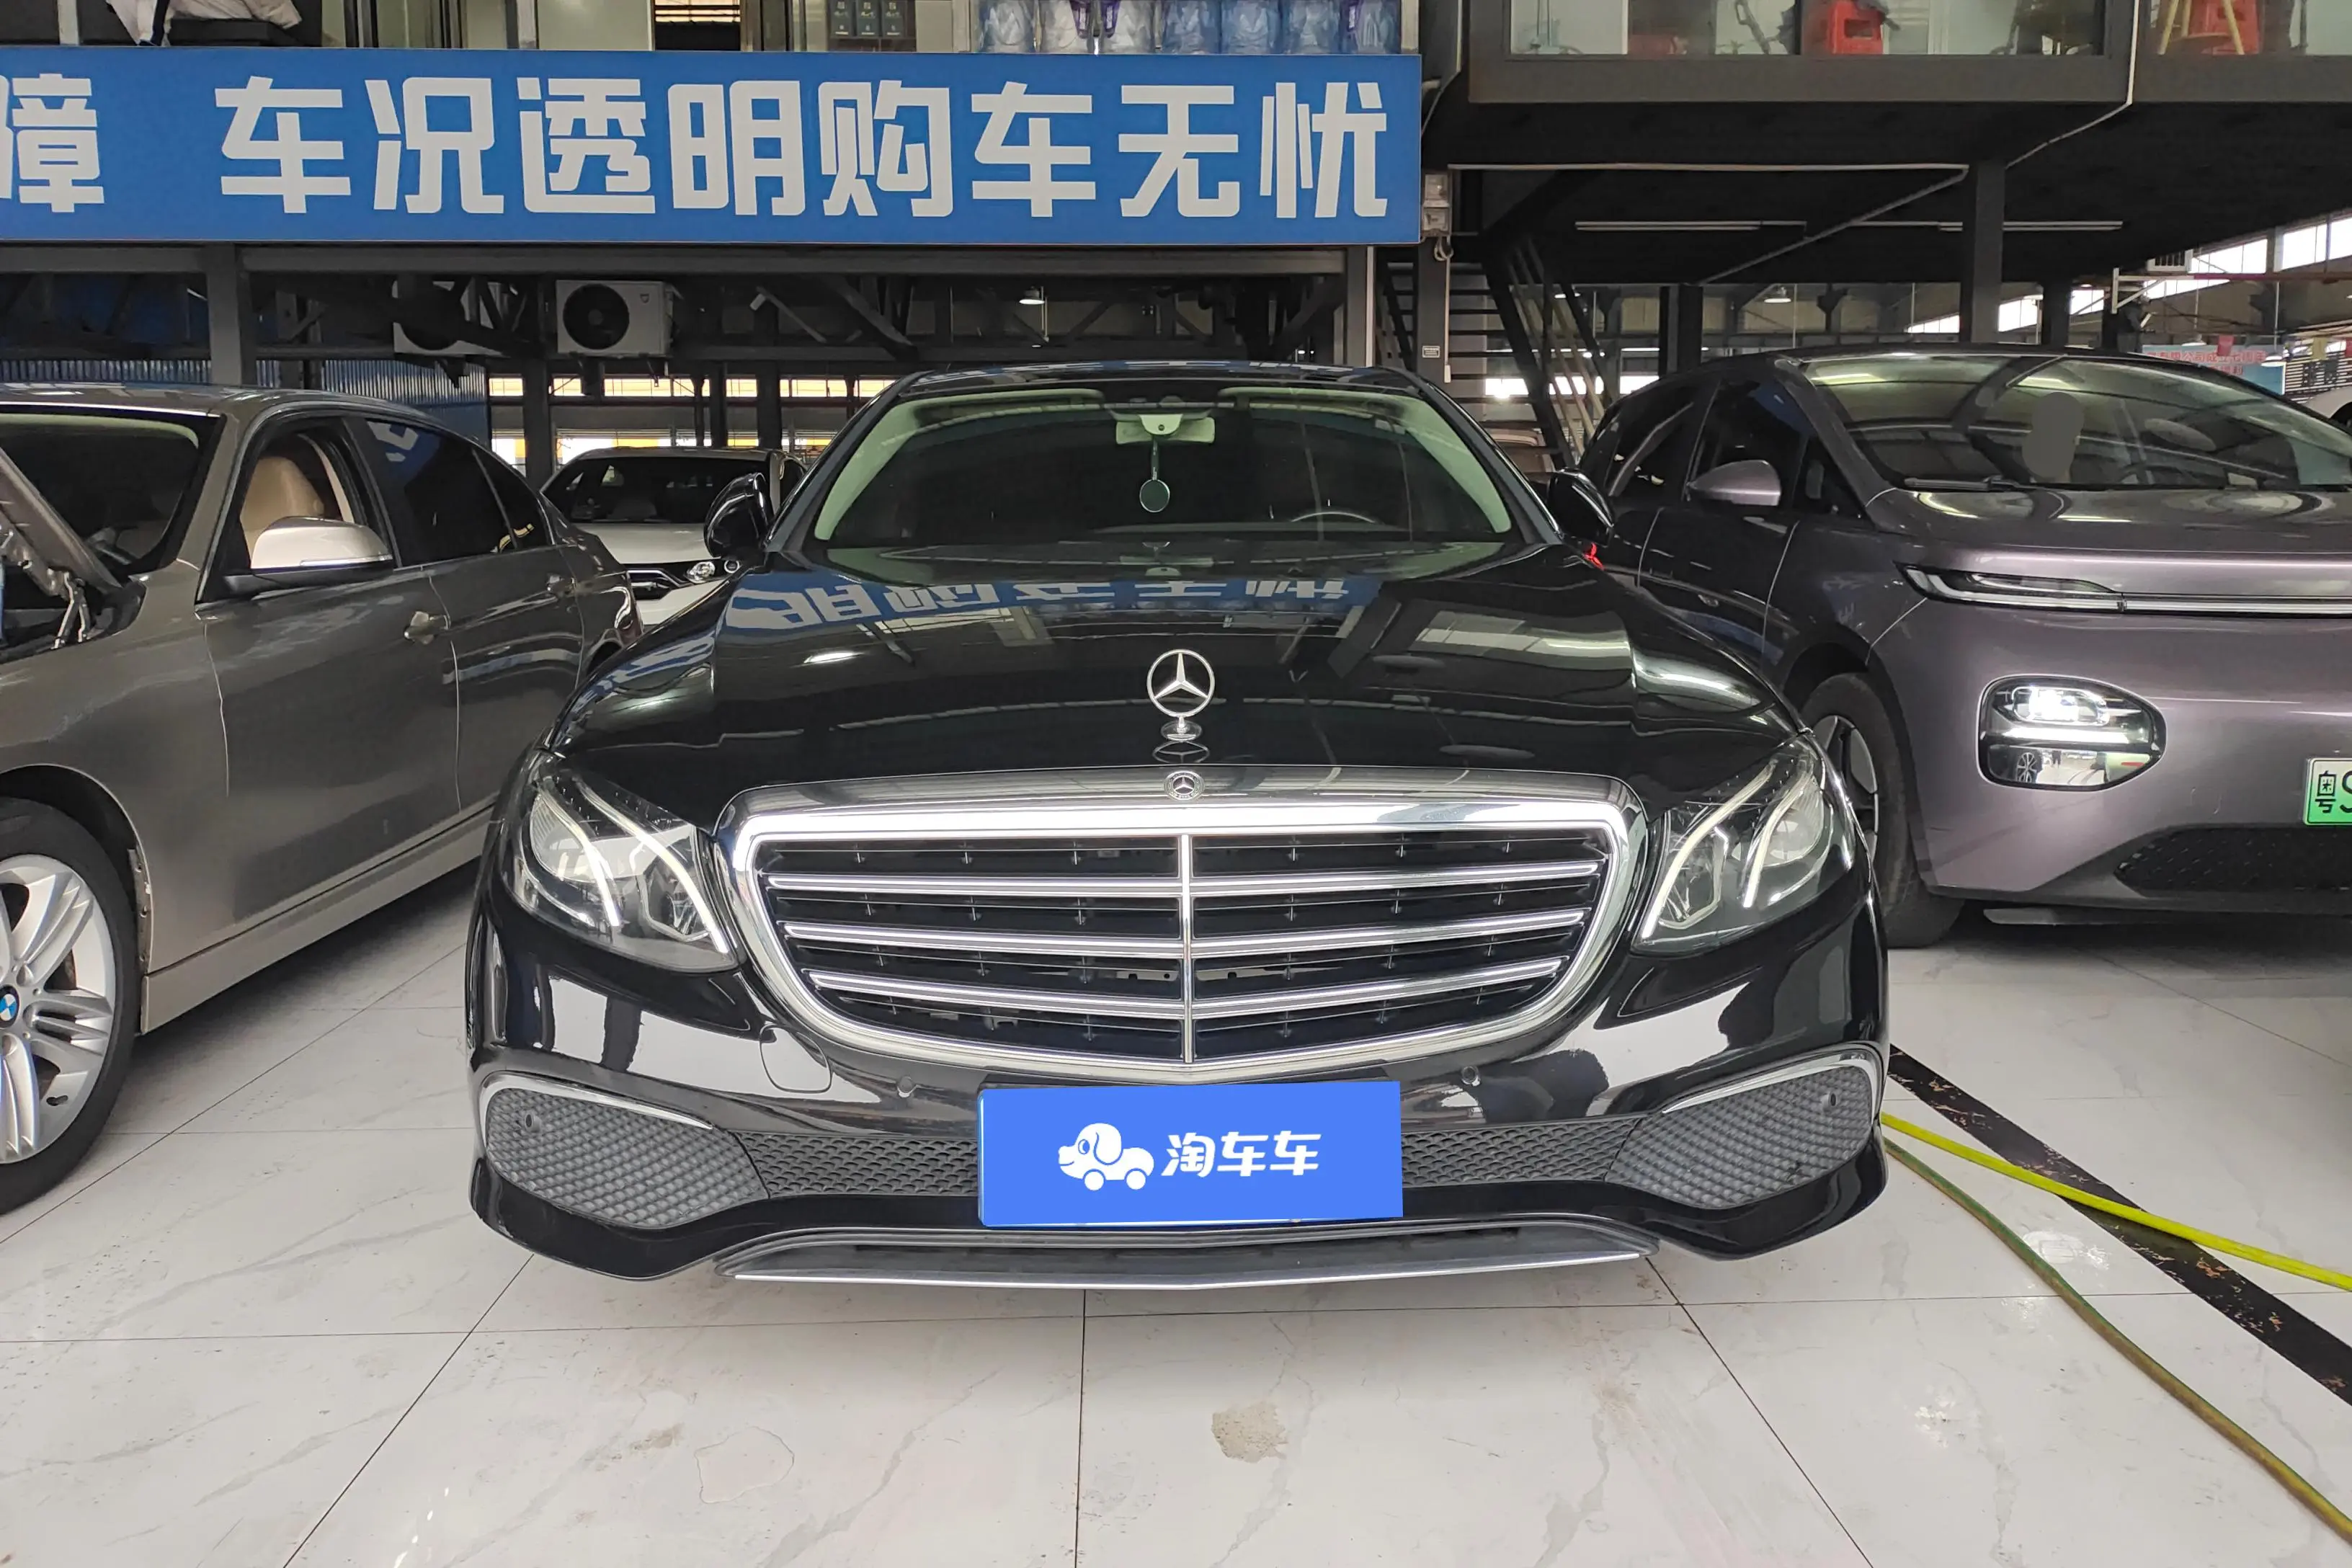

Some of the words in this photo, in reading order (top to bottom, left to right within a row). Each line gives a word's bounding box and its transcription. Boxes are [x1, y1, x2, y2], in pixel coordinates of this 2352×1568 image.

[215, 76, 1388, 218] 车况透明购车无忧
